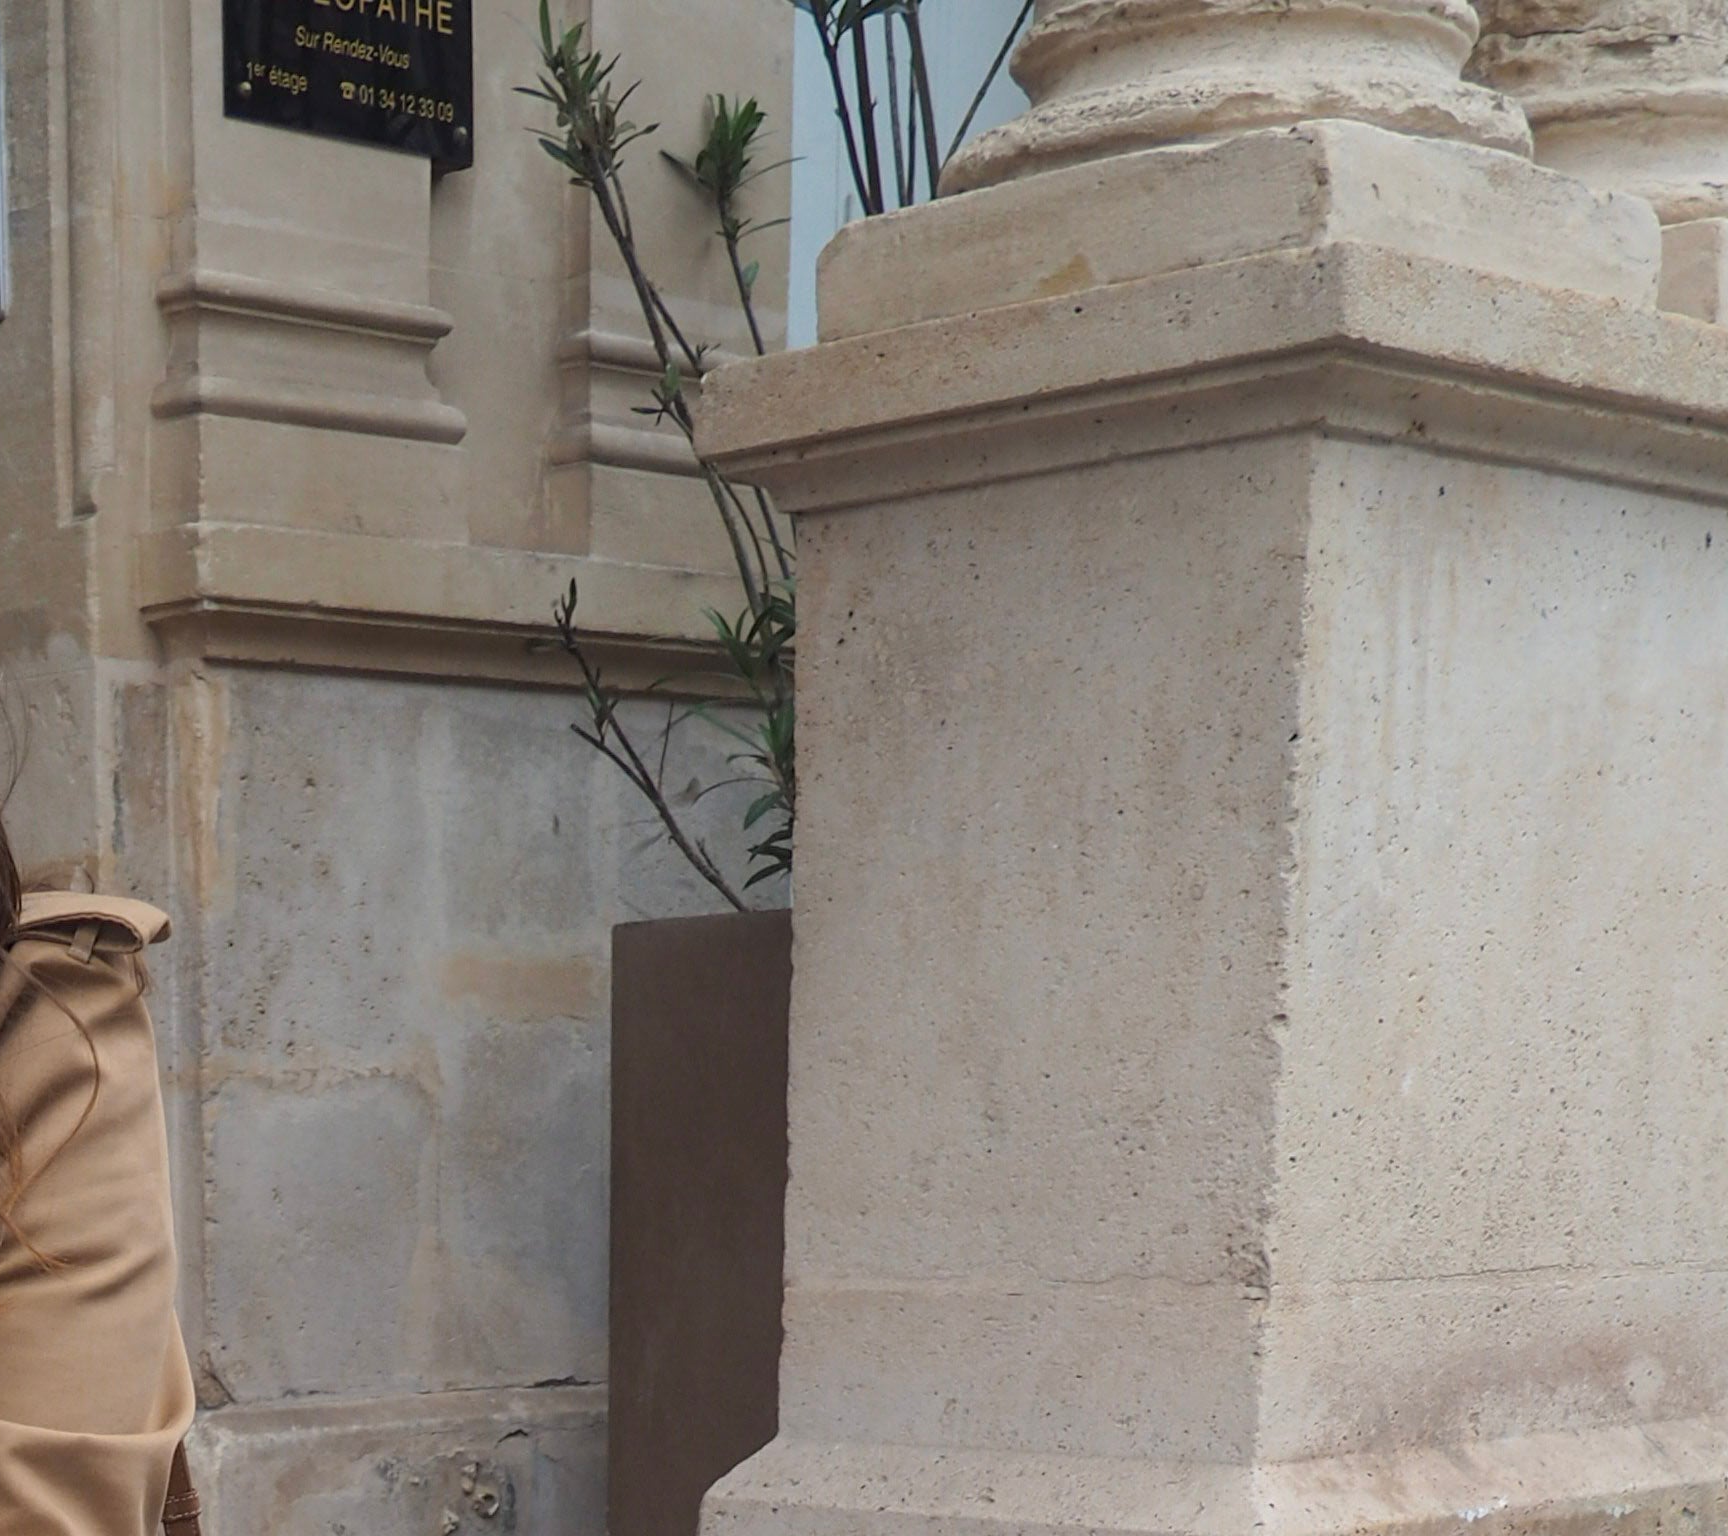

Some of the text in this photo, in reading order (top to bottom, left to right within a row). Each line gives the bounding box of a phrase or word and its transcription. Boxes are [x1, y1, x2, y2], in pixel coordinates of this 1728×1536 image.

[314, 0, 454, 35] ATHE
[295, 25, 411, 69] Sur Rendez-Vous
[246, 61, 308, 96] 1er étage
[359, 84, 374, 106] 01
[400, 93, 416, 114] 12
[419, 96, 435, 119] 33
[438, 101, 454, 123] 09
